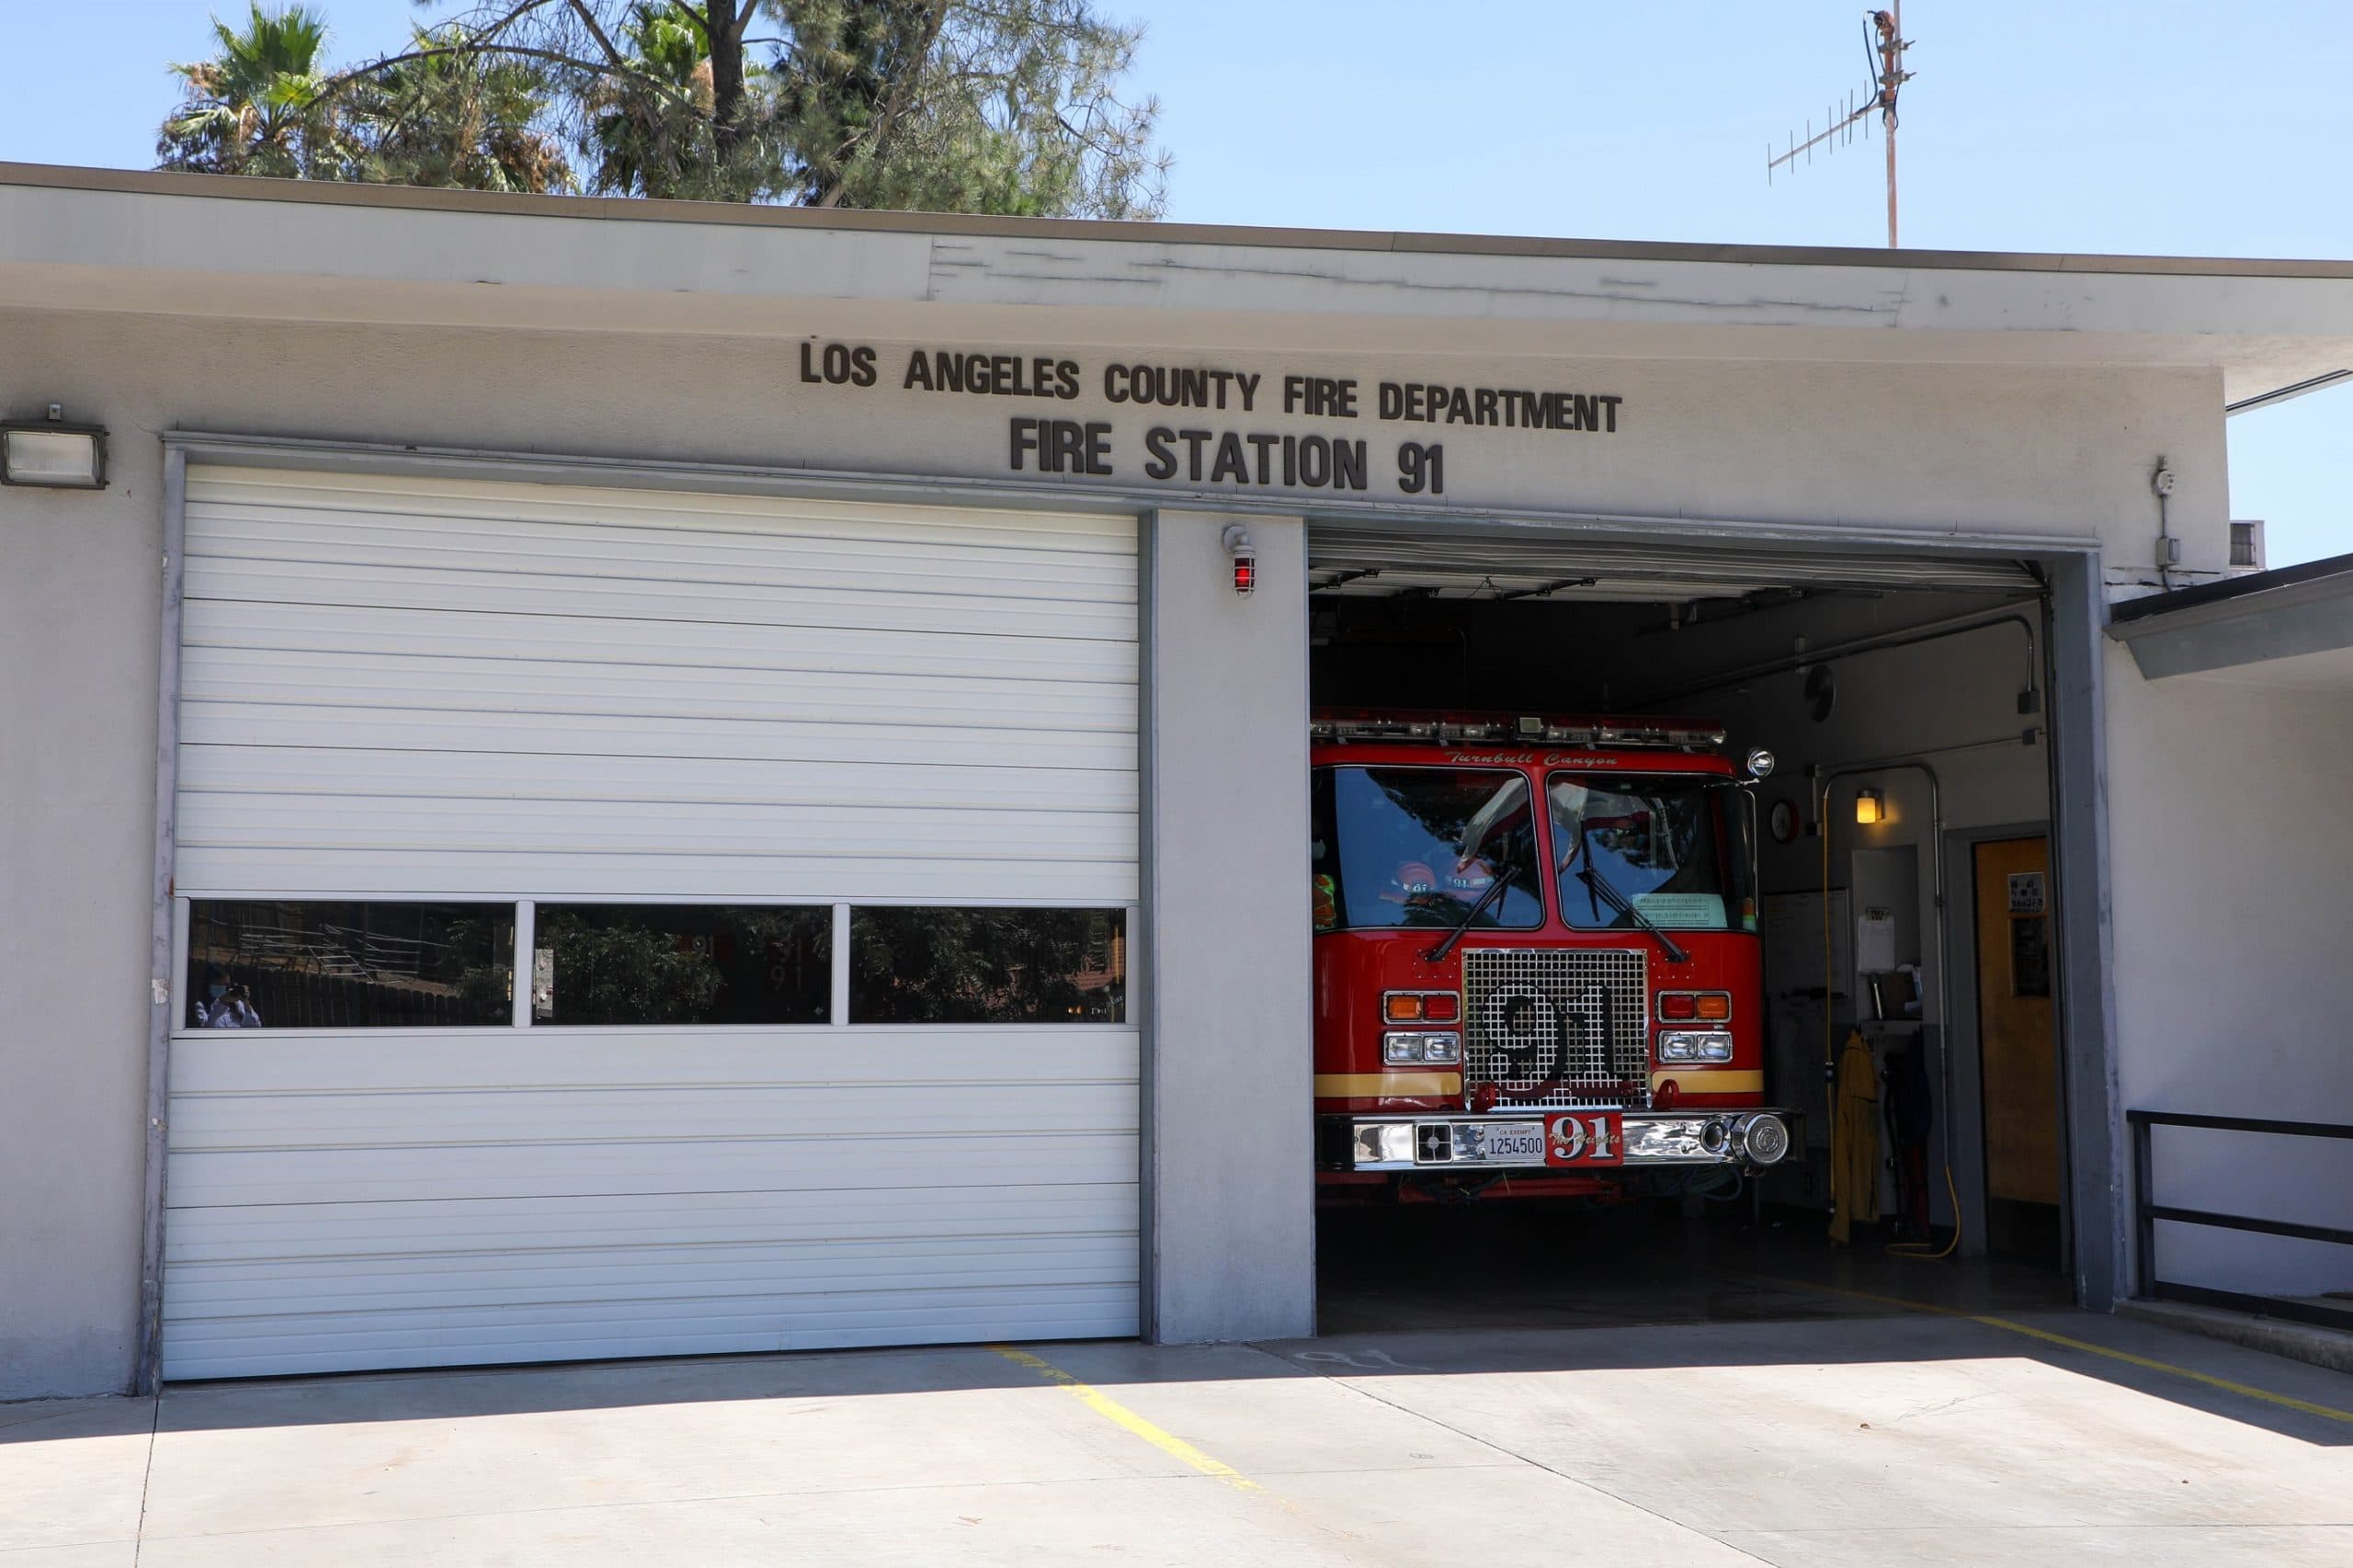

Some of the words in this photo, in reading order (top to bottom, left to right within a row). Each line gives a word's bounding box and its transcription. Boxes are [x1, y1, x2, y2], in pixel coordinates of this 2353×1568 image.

[801, 342, 877, 387] LOS
[904, 351, 1080, 400] ANGELES
[1104, 364, 1260, 411] COUNTY
[1284, 376, 1358, 418] FIRE
[1380, 382, 1622, 433] DEPARTMENT
[1010, 417, 1113, 475] FIRE
[1145, 426, 1367, 490] STATION
[1398, 442, 1444, 494] 91
[1444, 749, 1533, 764] Turnbull
[1543, 752, 1618, 767] Canyon
[1482, 983, 1625, 1094] 91
[1489, 1138, 1542, 1154] 1254500
[1552, 1117, 1615, 1160] 91
[1574, 1132, 1620, 1147] Heights
